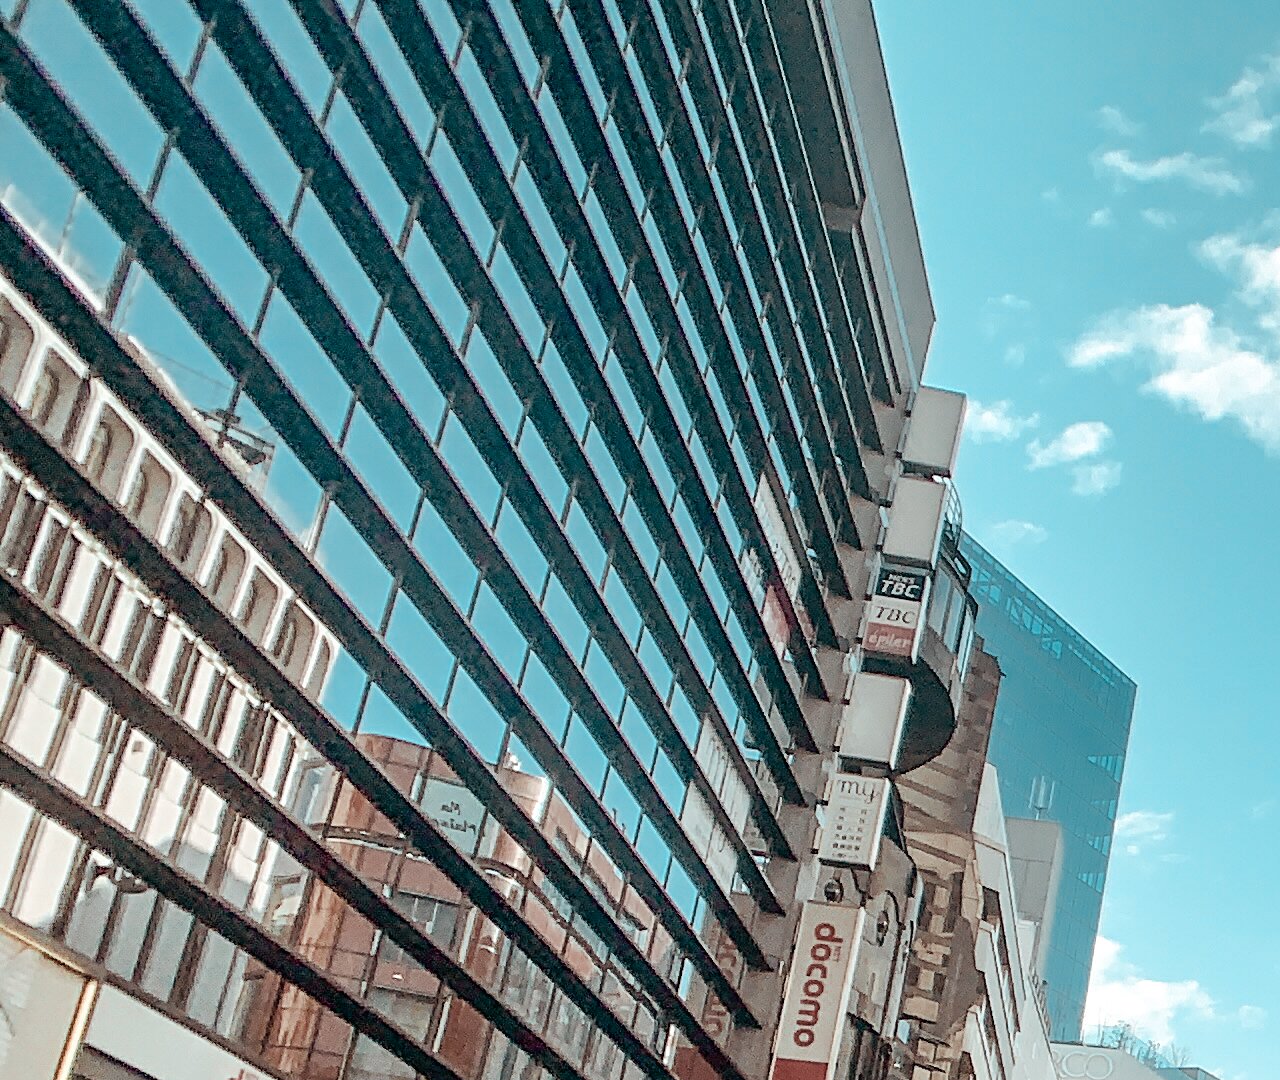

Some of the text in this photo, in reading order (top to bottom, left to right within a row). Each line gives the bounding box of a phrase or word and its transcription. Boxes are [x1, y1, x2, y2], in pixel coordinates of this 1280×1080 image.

[881, 580, 919, 598] TBC
[876, 606, 915, 624] TBC
[793, 922, 843, 1047] docomo
